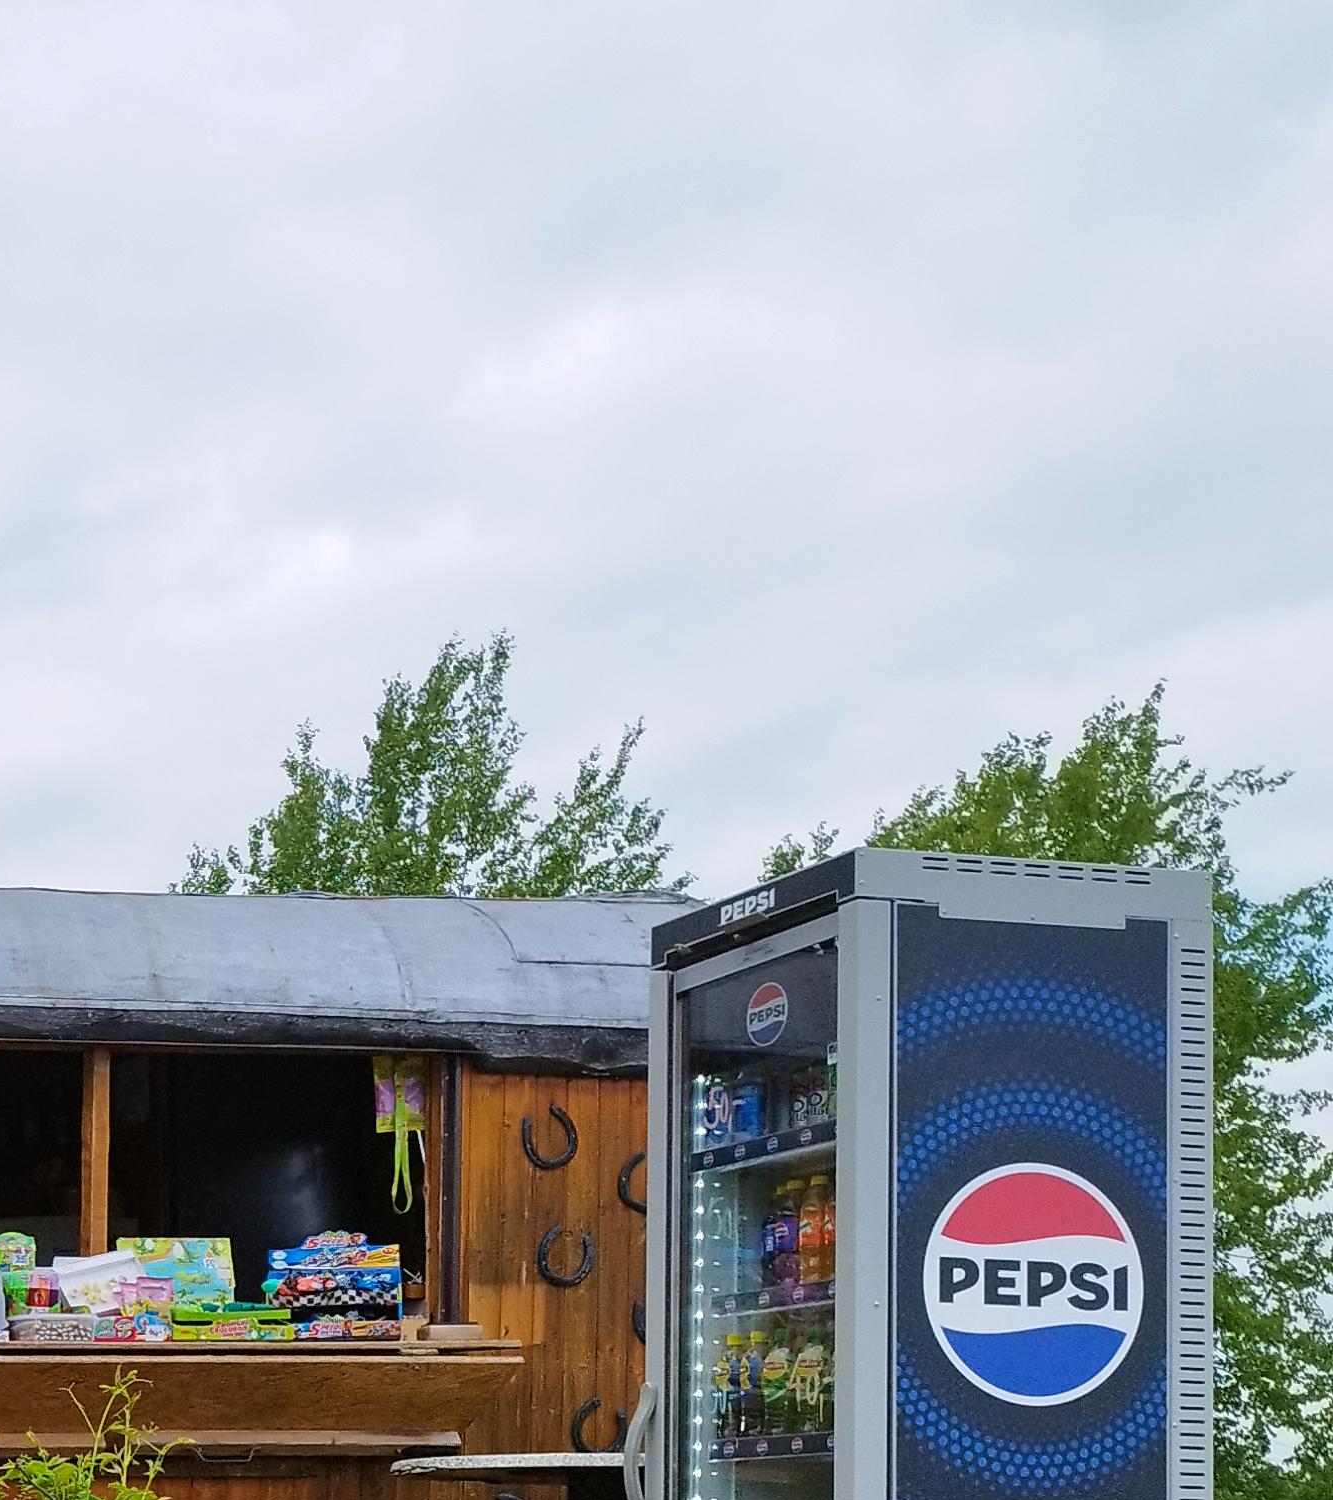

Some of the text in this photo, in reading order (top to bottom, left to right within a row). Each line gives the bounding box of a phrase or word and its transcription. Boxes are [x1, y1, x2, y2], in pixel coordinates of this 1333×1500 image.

[720, 887, 776, 925] PEPSI
[749, 1004, 786, 1026] PEPSI
[939, 1256, 1129, 1312] PEPSI
